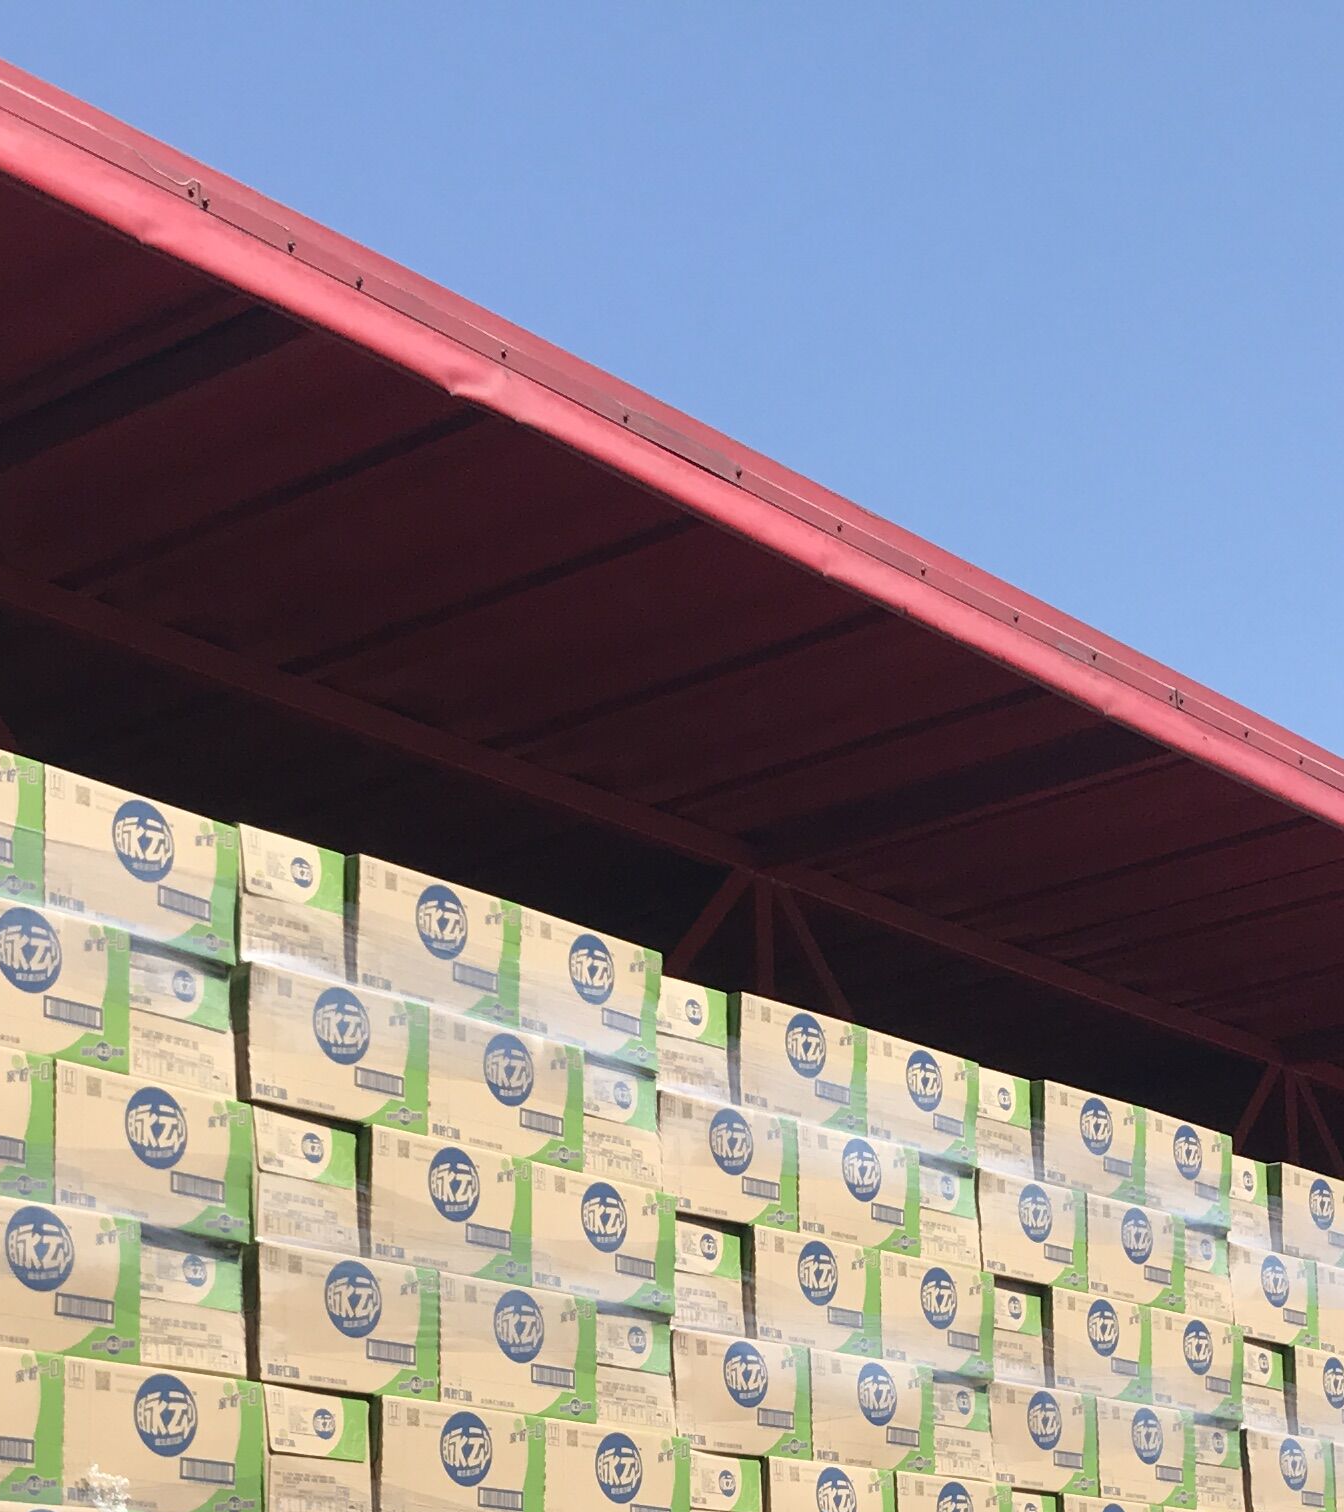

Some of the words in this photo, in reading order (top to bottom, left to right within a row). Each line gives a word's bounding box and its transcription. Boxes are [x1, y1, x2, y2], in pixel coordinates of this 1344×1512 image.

[114, 816, 172, 868] 脉动
[127, 1103, 184, 1154] 脉动
[6, 1222, 72, 1275] 脉动
[136, 1390, 195, 1440] 脉动
